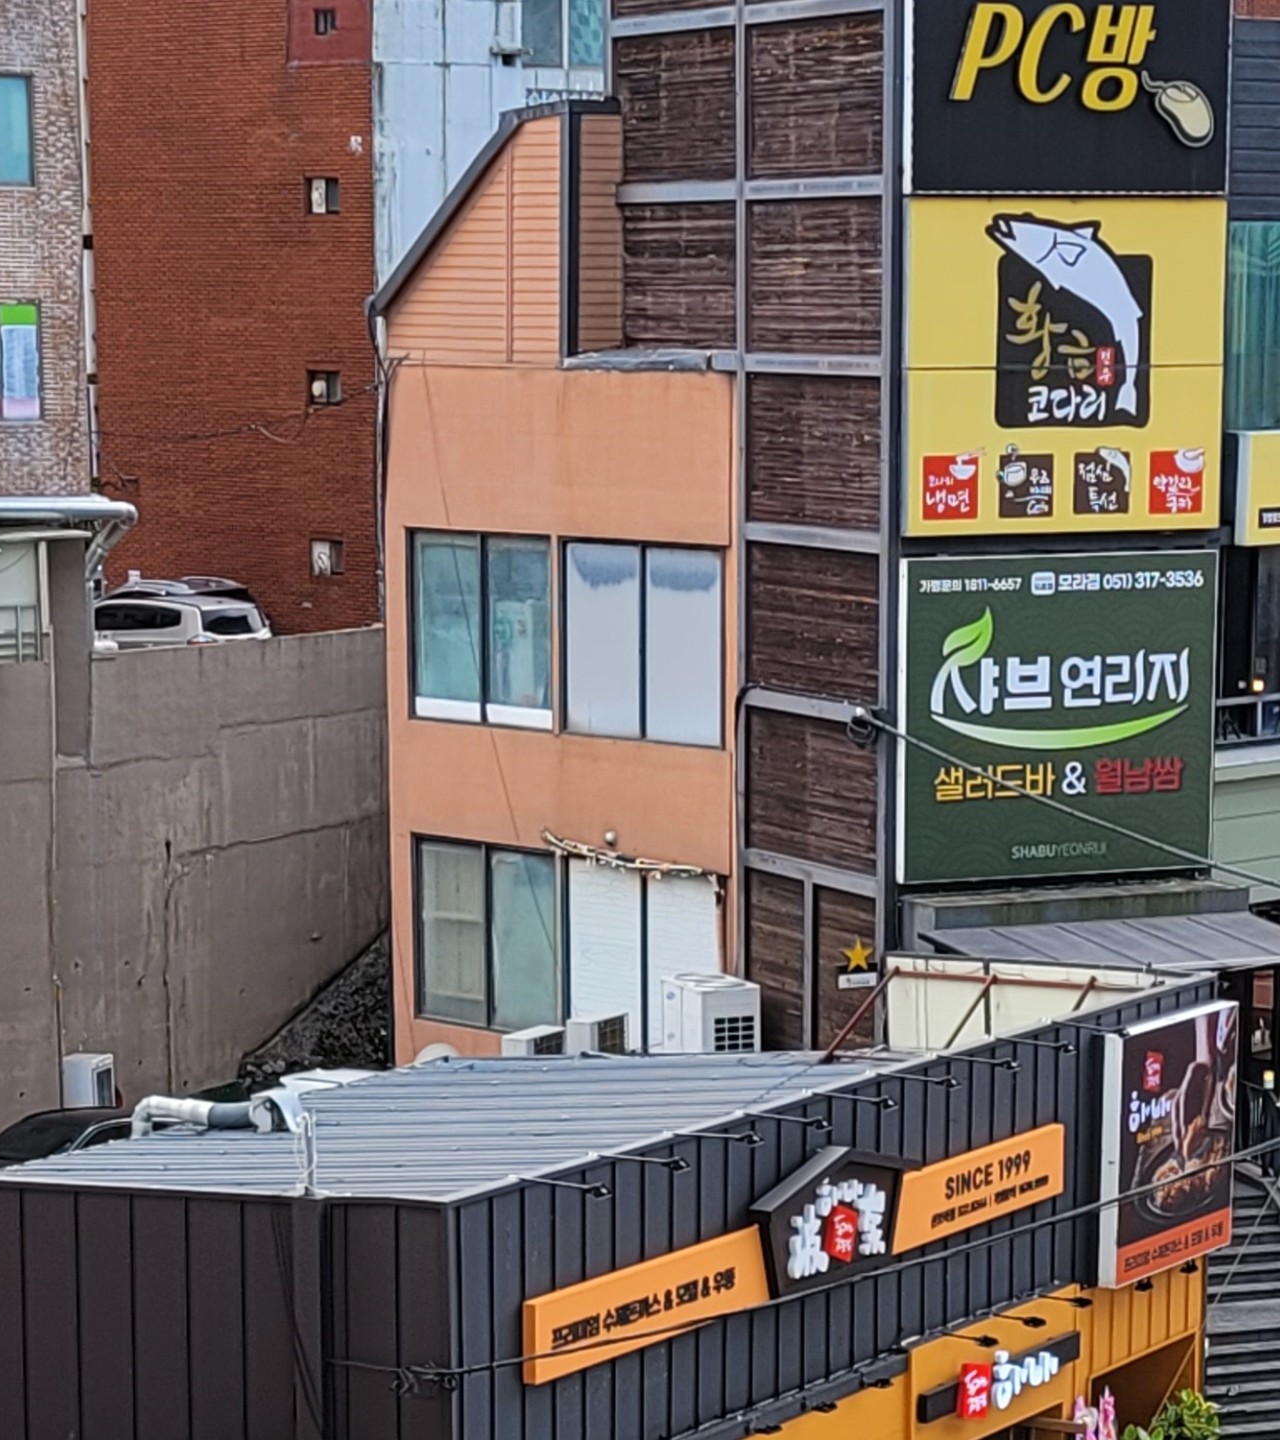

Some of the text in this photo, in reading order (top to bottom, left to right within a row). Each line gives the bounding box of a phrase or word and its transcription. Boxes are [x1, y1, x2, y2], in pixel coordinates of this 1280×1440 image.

[950, 3, 1157, 112] PC방
[933, 754, 1184, 803] 샐러드바 & 월남쌈
[944, 1162, 994, 1201] SINCE
[997, 1149, 1031, 1182] 1999
